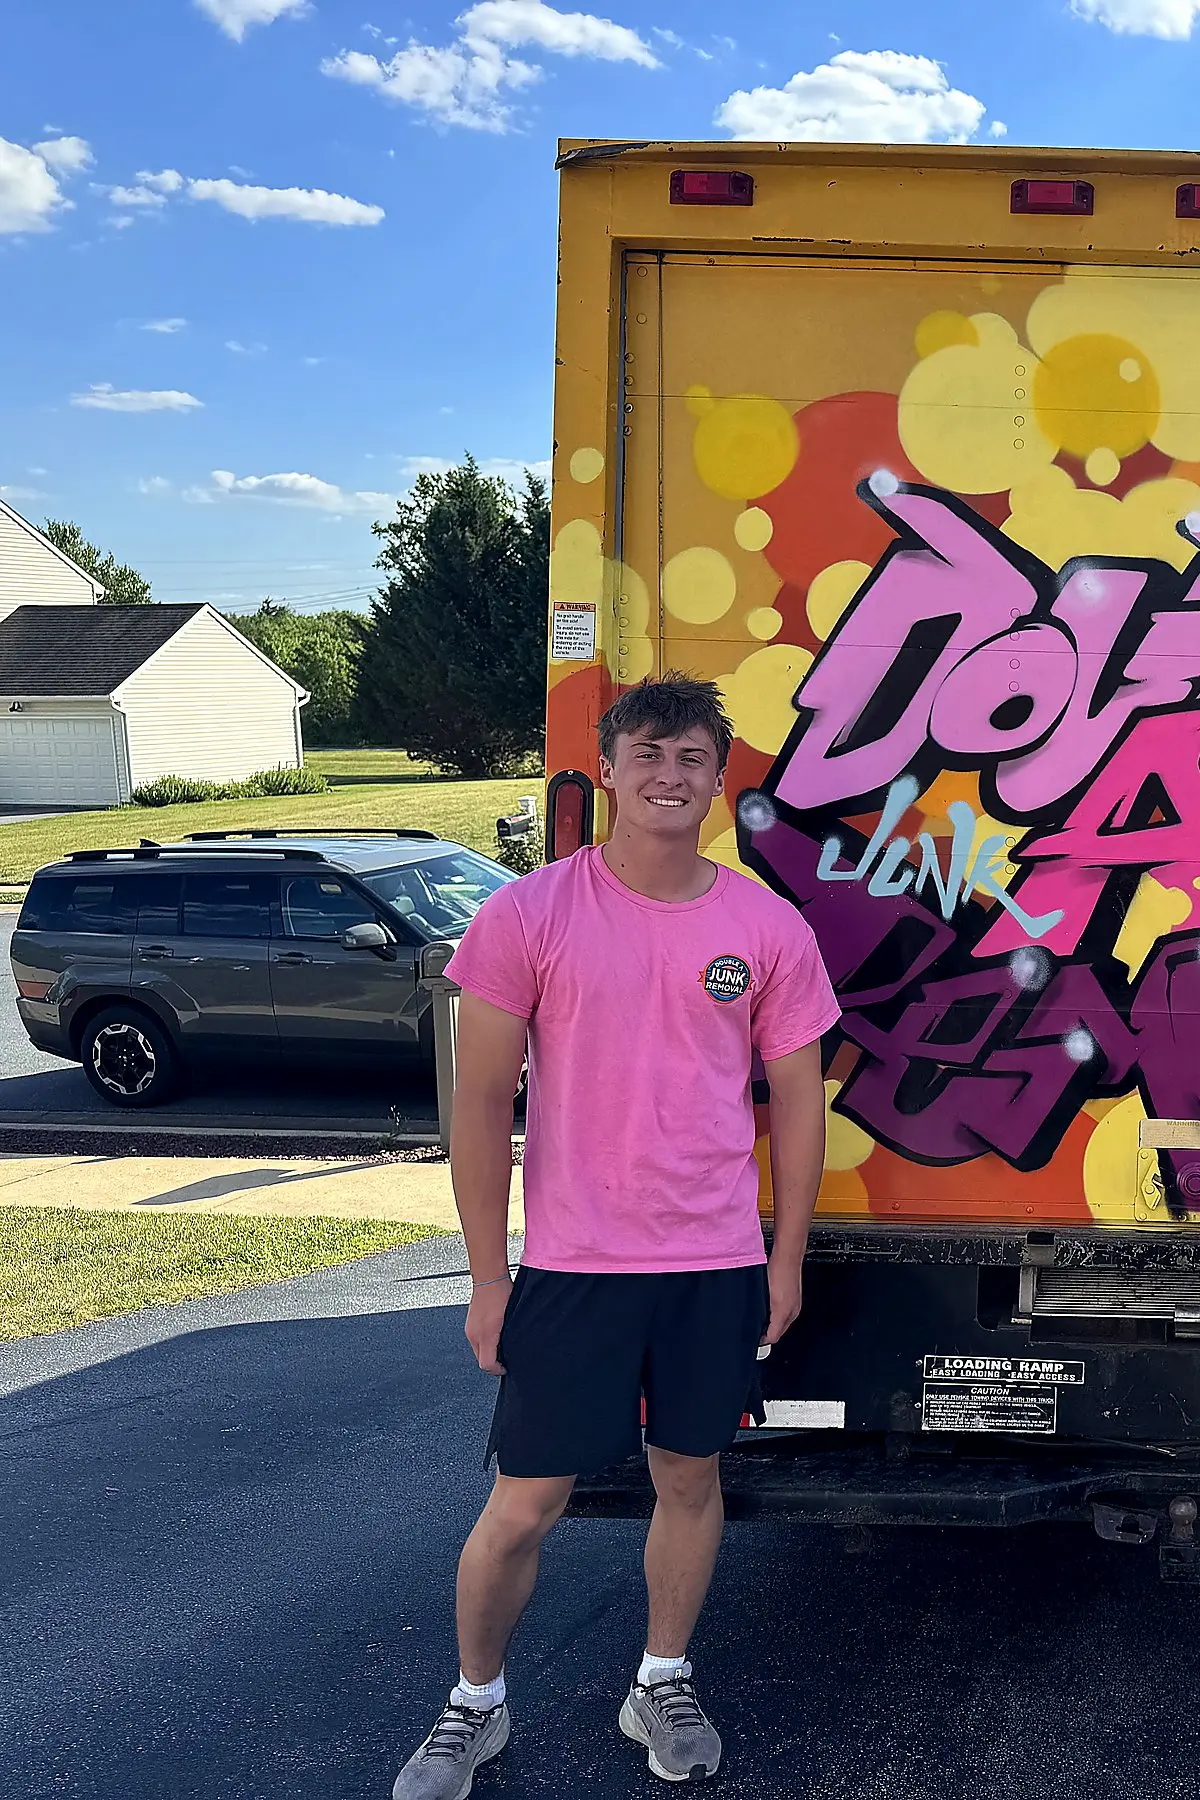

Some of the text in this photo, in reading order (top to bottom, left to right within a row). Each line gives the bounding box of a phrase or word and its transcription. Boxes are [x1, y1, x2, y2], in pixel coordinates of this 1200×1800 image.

[816, 774, 1065, 939] JUNK
[715, 960, 740, 968] DOUBLE
[709, 967, 746, 986] JUNK
[705, 981, 743, 994] REMOVAL
[944, 1359, 1064, 1373] LOADING RAMP
[960, 1369, 1000, 1378] LOADING
[1038, 1372, 1076, 1381] ACCESS
[970, 1387, 1010, 1395] CAUTION
